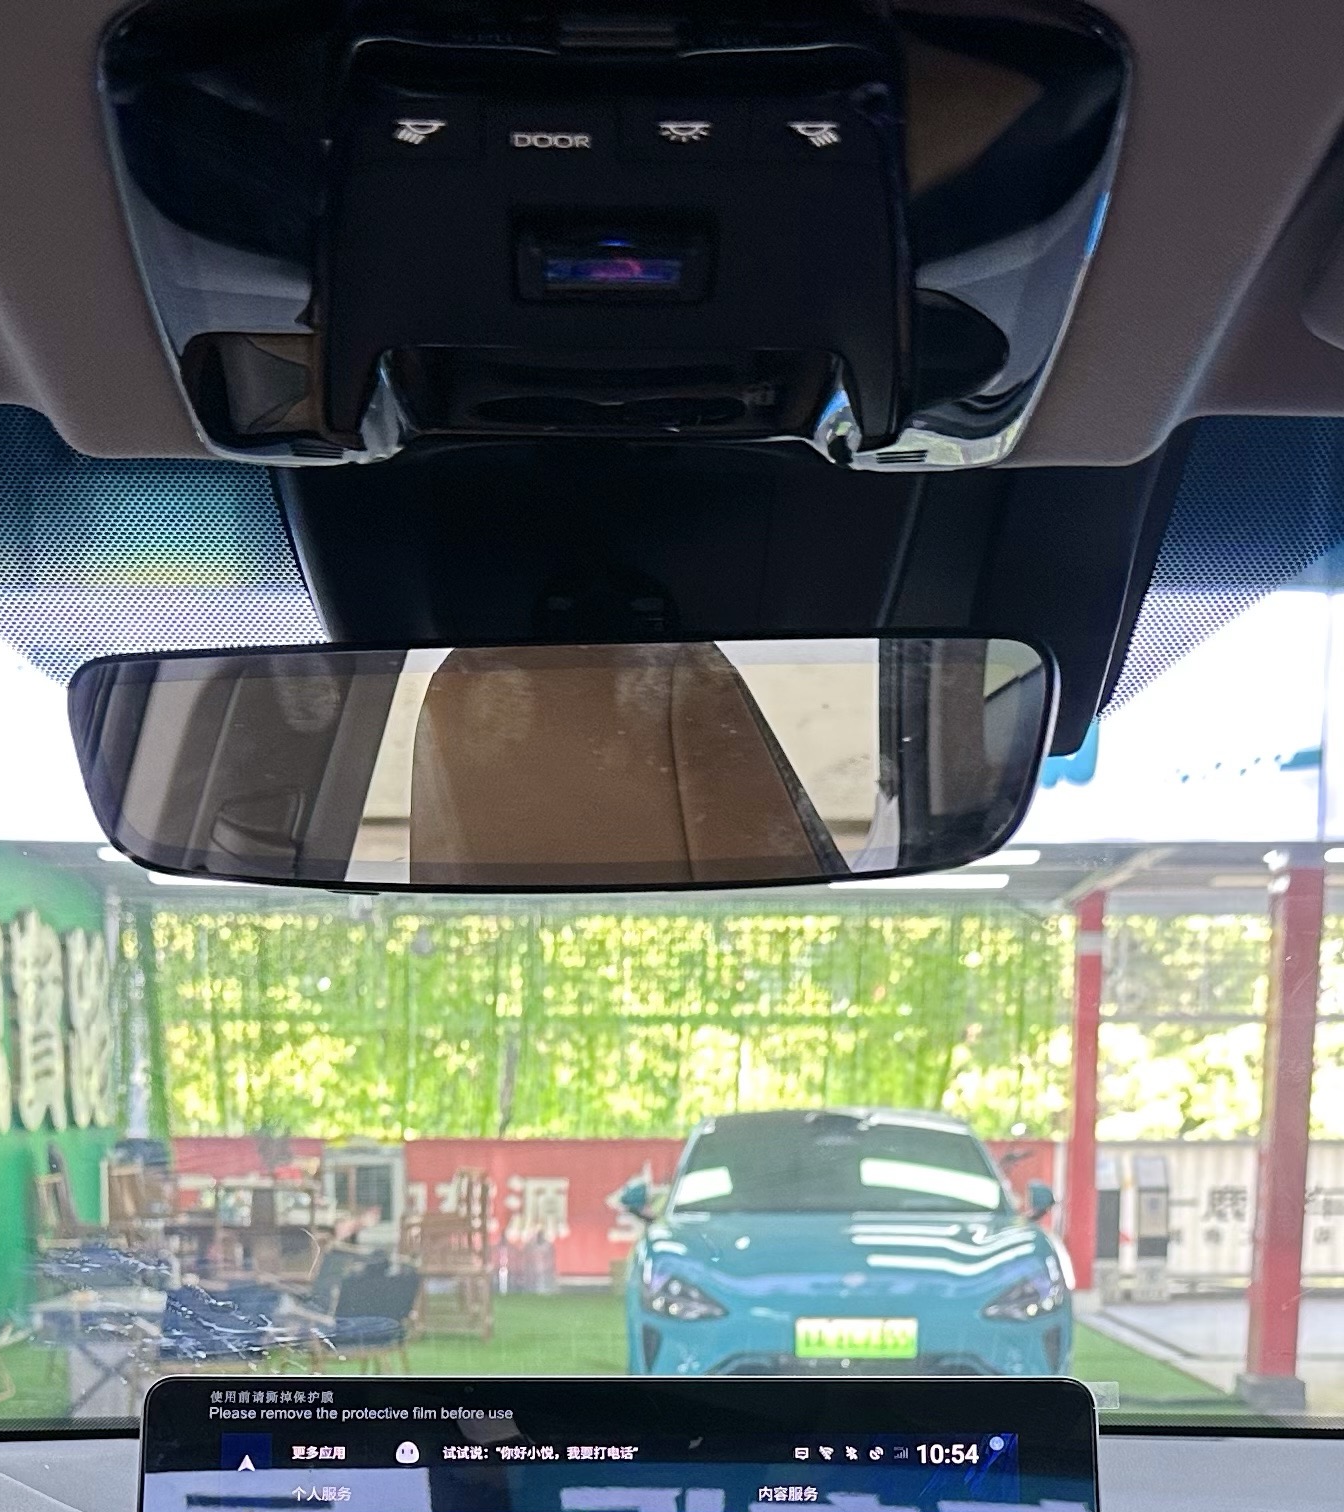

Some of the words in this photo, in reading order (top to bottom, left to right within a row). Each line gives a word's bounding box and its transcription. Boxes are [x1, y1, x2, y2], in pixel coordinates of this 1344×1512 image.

[512, 132, 592, 150] DOOR
[210, 1390, 334, 1405] 使用前请撕掉保护膜
[209, 1406, 256, 1420] Please
[260, 1409, 314, 1420] remove
[316, 1406, 338, 1420] the
[342, 1406, 409, 1422] protective
[412, 1406, 437, 1420] film
[440, 1407, 485, 1420] before
[488, 1410, 514, 1420] use
[292, 1445, 347, 1461] 更多应用
[916, 1443, 979, 1465] 10:54
[292, 1486, 352, 1503] 个人服务
[758, 1486, 819, 1502] 内容服务
